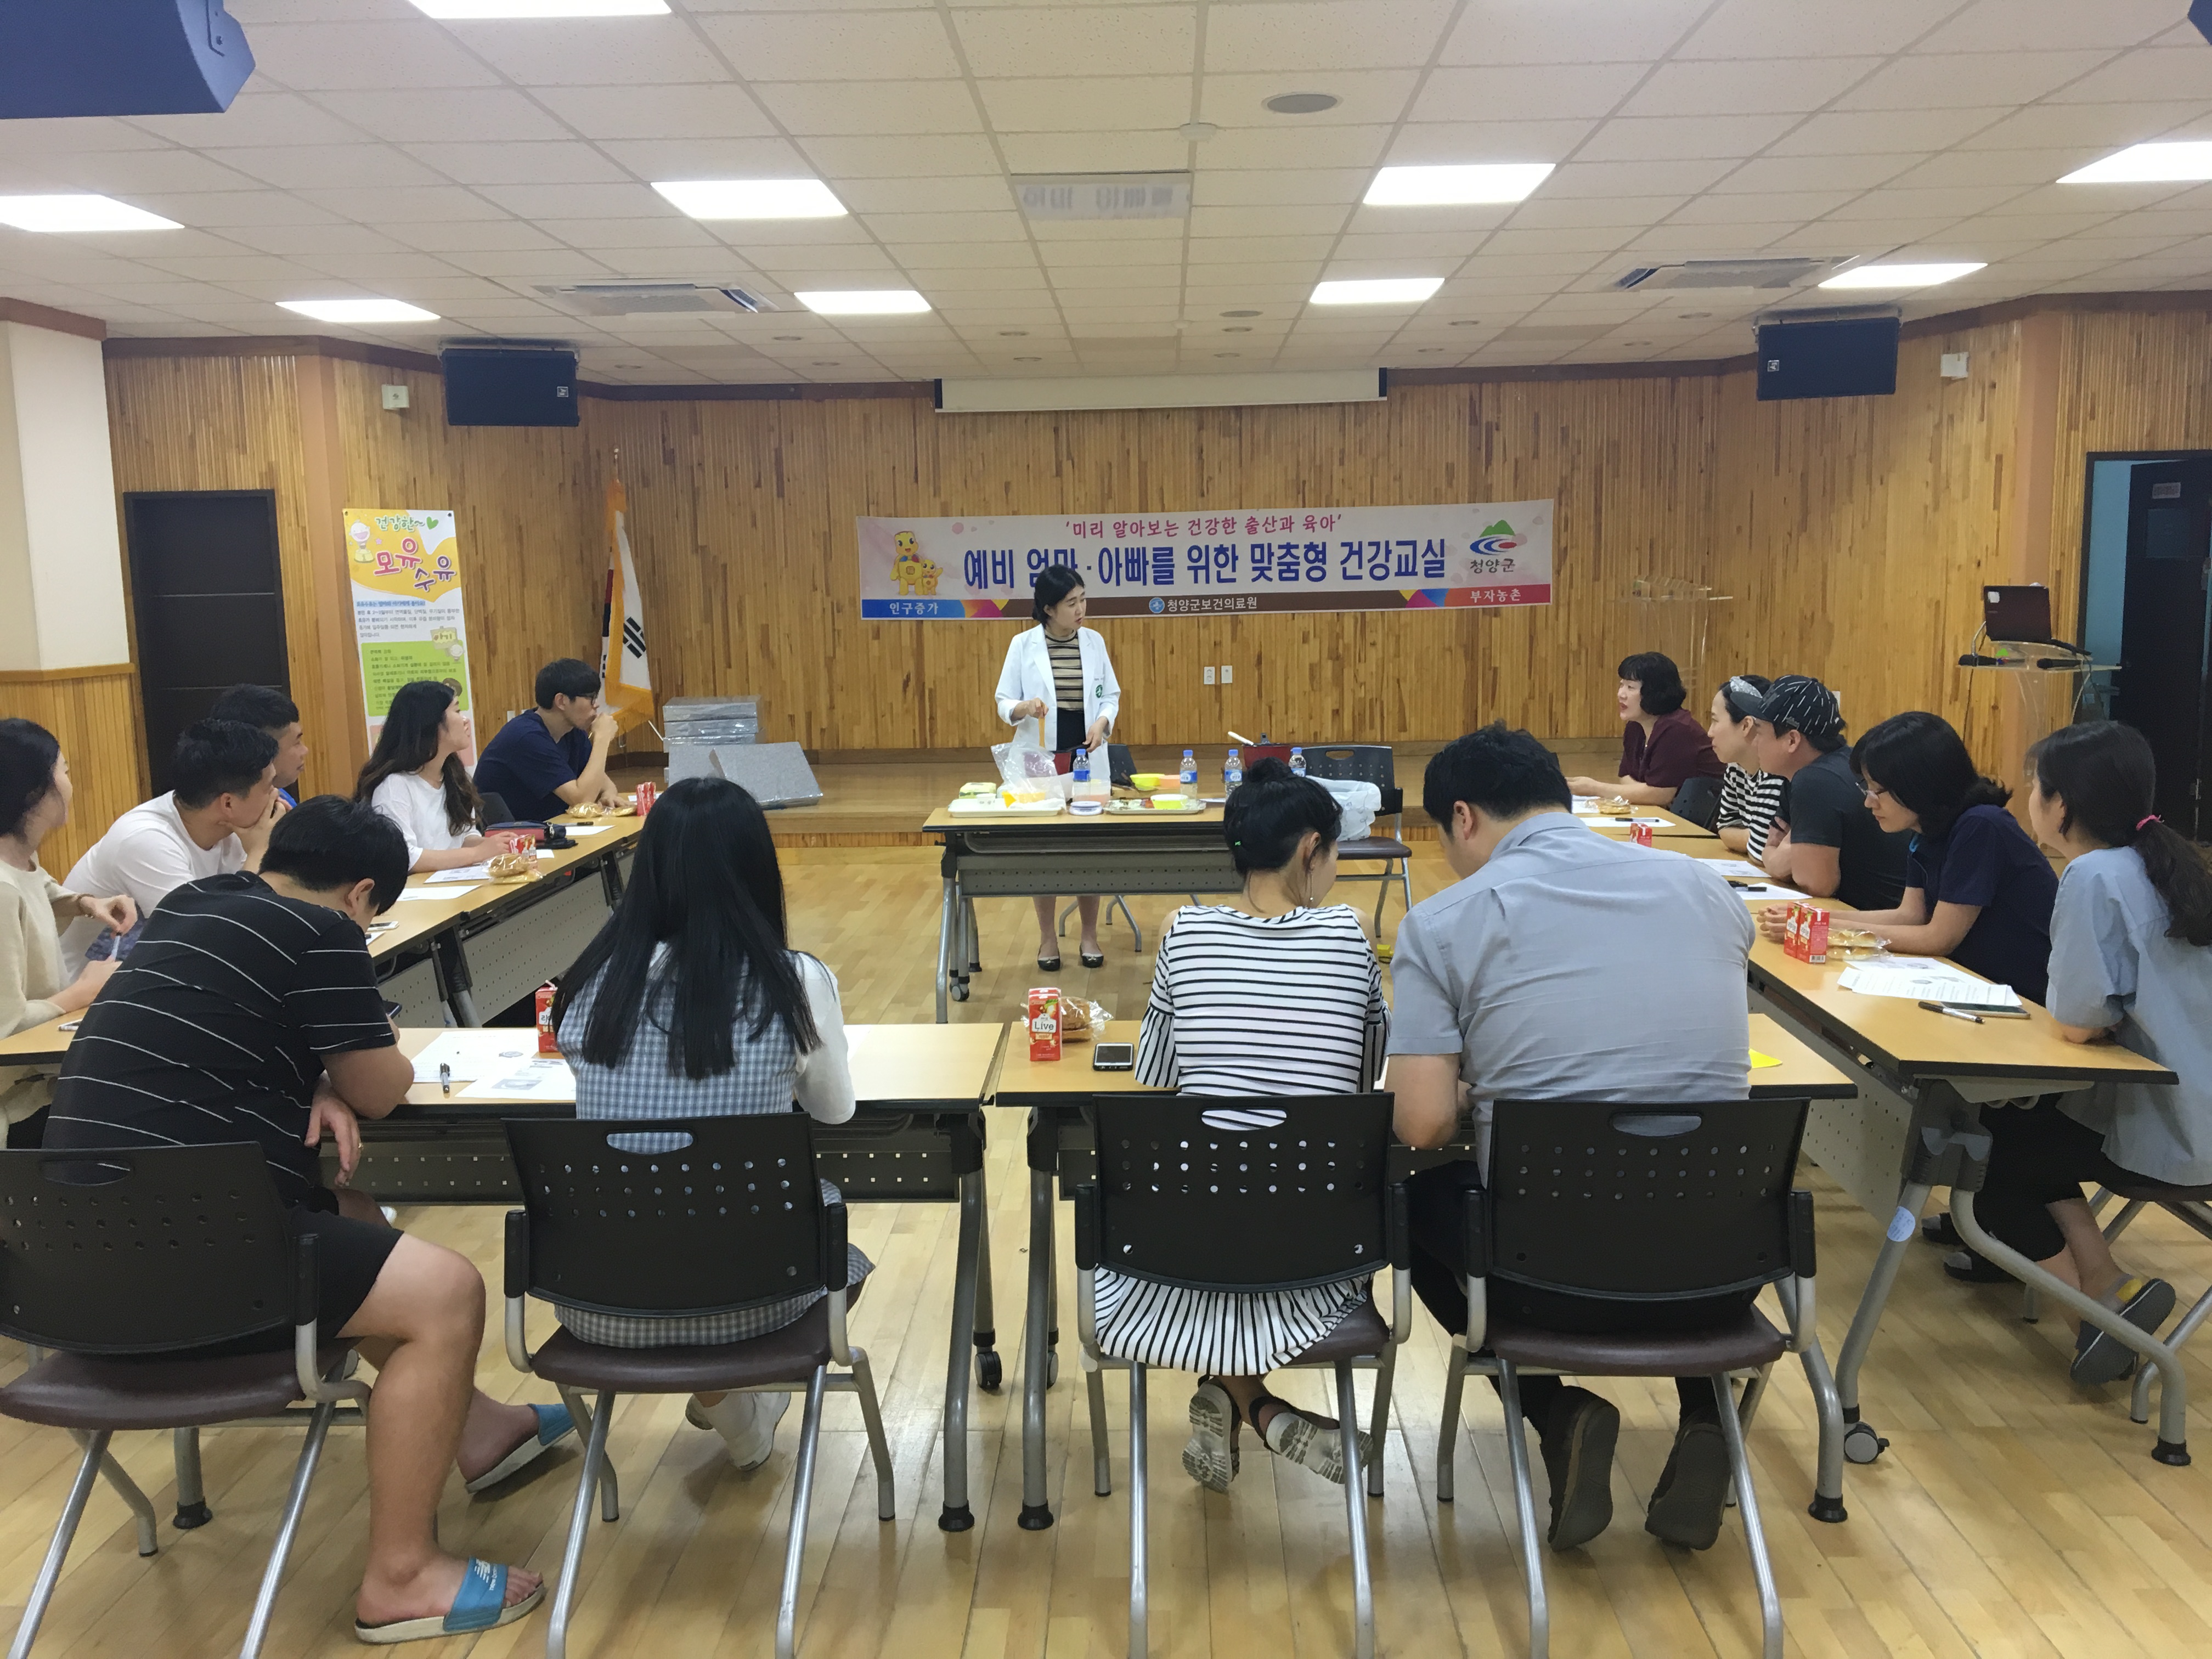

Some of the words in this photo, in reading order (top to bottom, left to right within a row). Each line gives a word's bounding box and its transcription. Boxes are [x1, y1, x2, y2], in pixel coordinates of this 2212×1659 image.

[1113, 520, 1179, 539] 알아보는
[1188, 516, 1237, 536] 건강한
[1245, 515, 1295, 535] 출산과
[374, 538, 421, 575] 모유
[964, 549, 1014, 589] 예비
[1187, 543, 1239, 584] 위한
[1250, 541, 1327, 583] 맞춤형
[1340, 538, 1446, 582] 건강교실
[1470, 558, 1516, 573] 청양군
[414, 556, 455, 591] 수유
[1470, 589, 1521, 603] 부자농촌
[889, 601, 939, 615] 인구증가
[1167, 597, 1257, 612] 청양군보건의료원
[1034, 1021, 1054, 1030] Live
